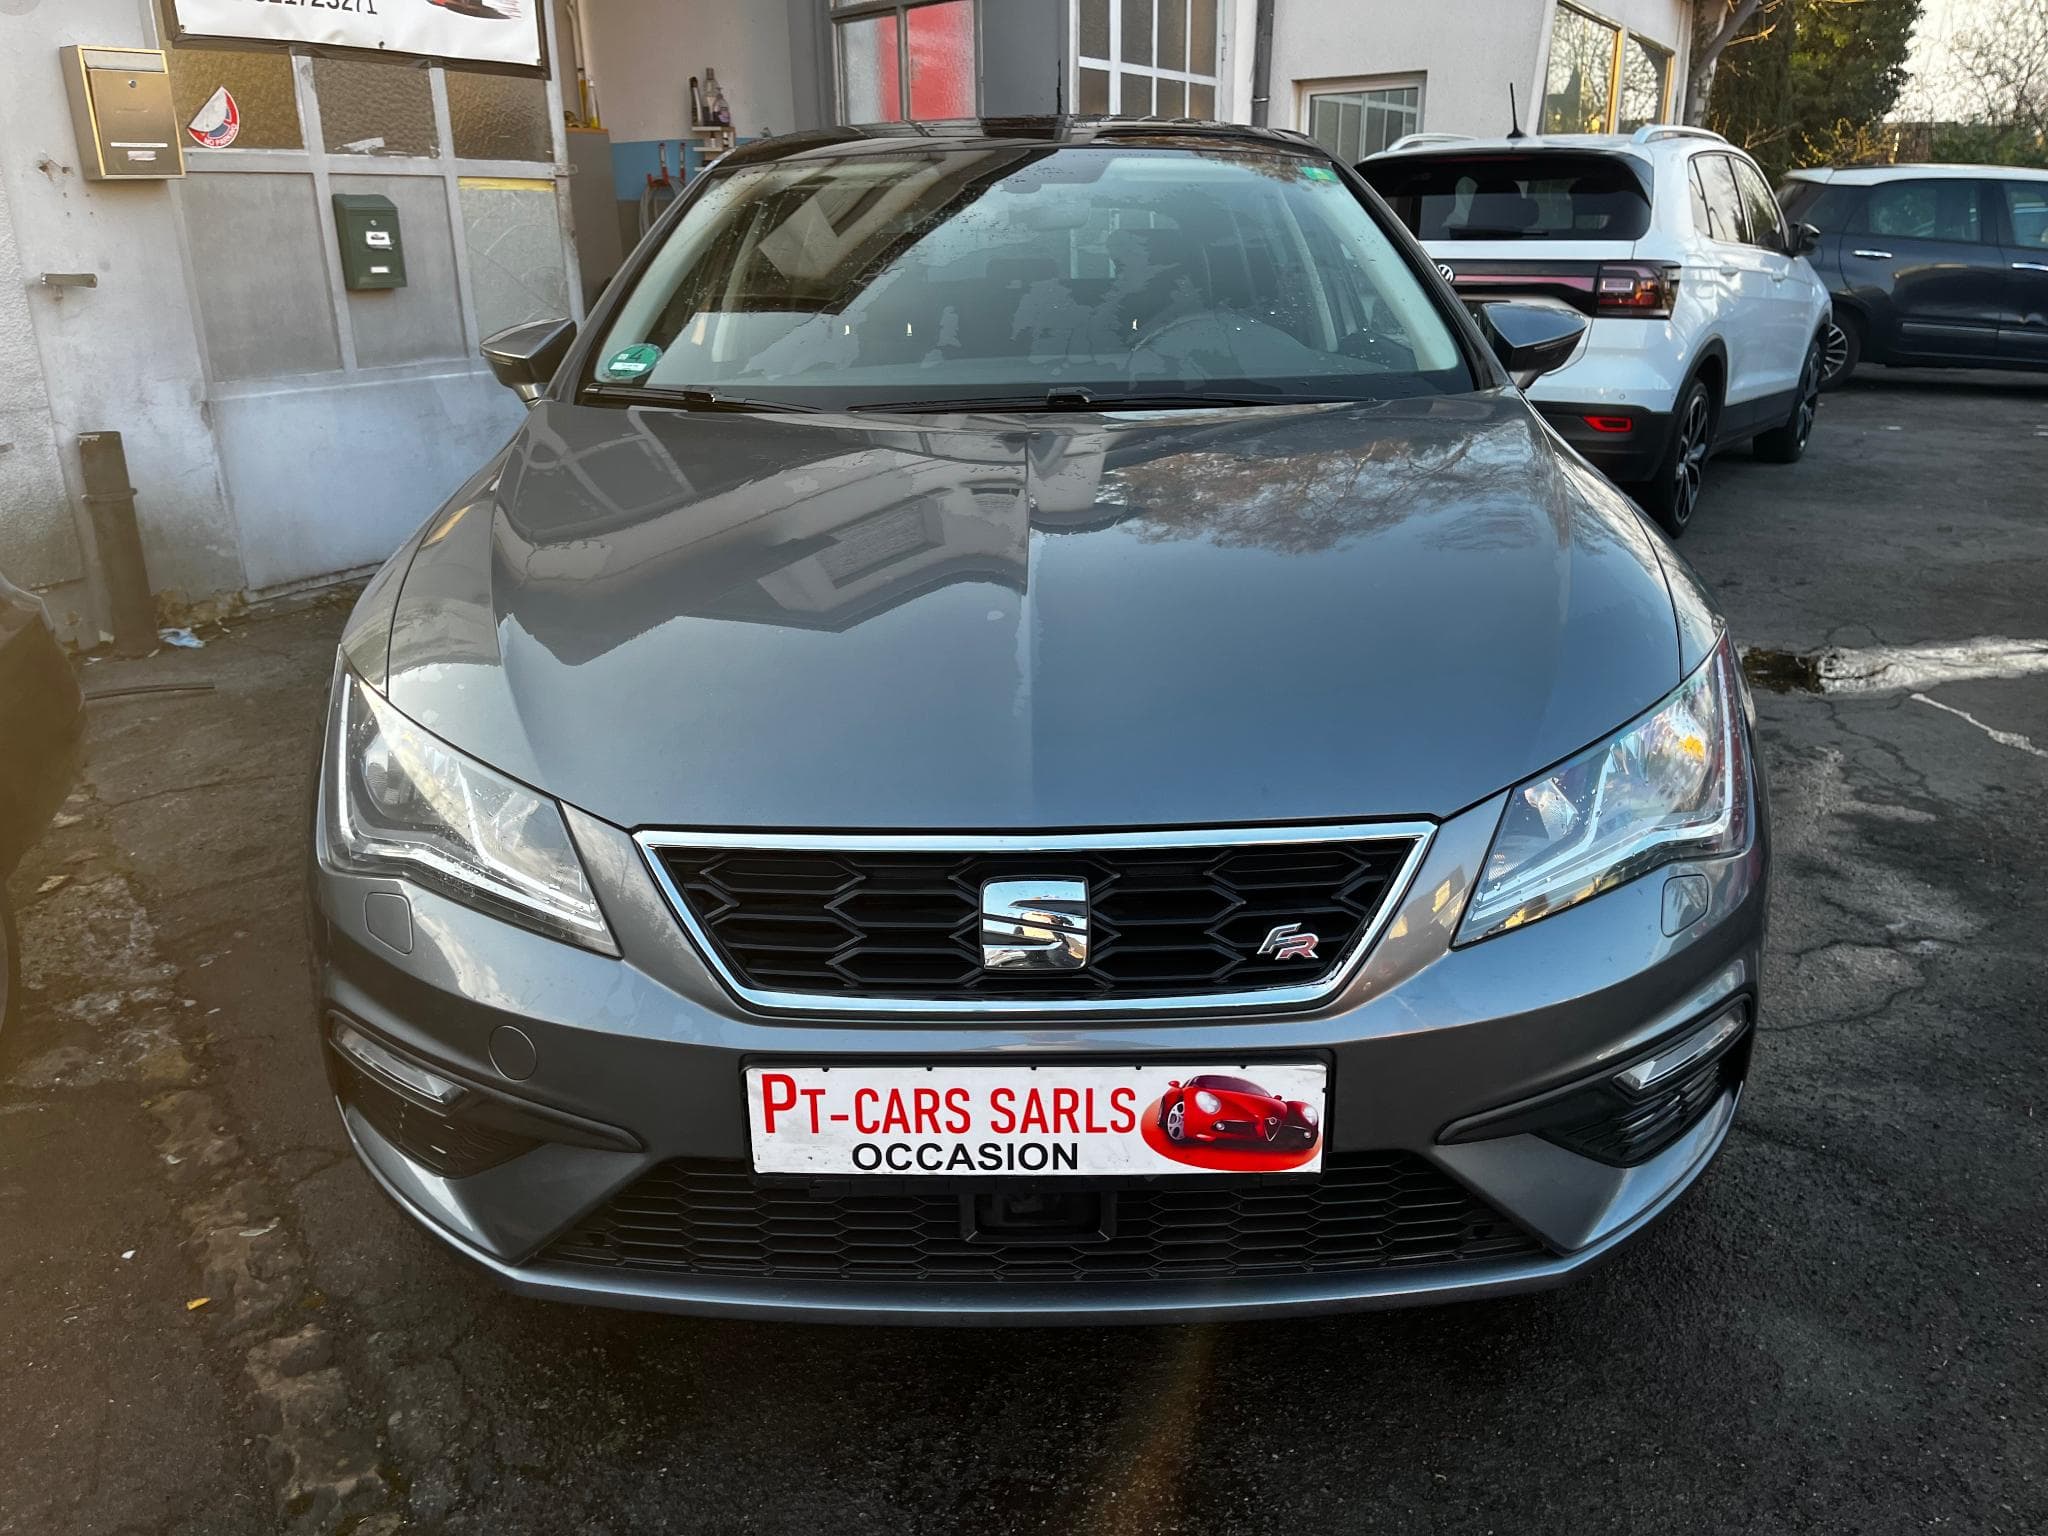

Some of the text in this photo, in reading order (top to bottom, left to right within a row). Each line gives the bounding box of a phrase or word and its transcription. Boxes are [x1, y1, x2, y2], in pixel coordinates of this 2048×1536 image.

[1256, 922, 1319, 960] FR
[761, 1073, 1136, 1134] PT-CARS SARLS
[852, 1142, 1078, 1171] OCCASION
